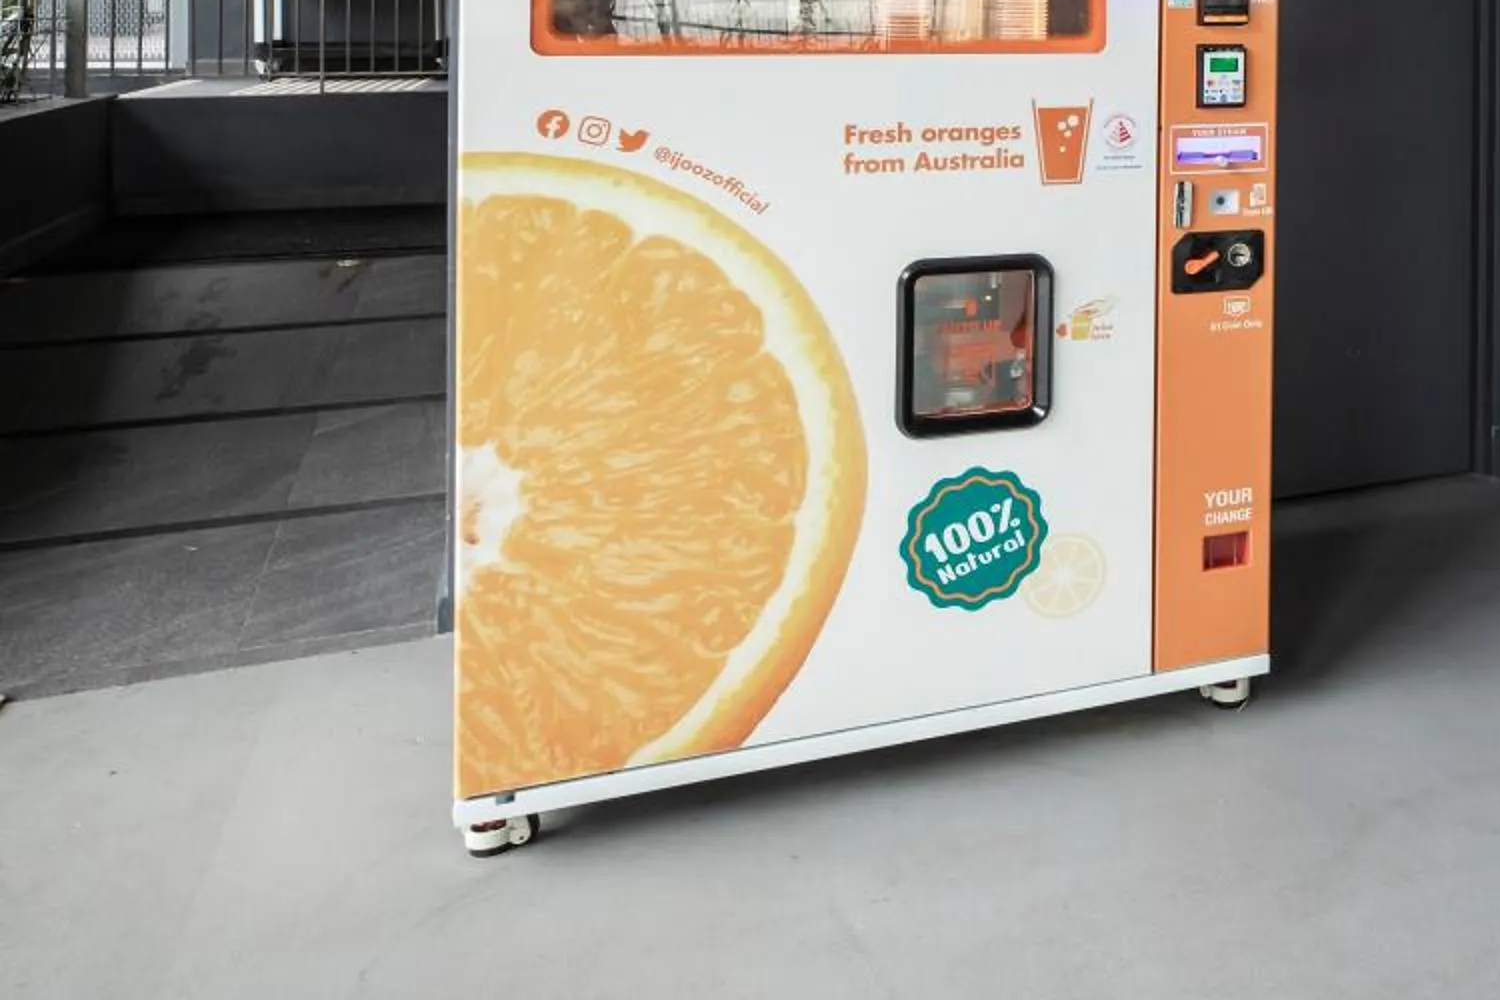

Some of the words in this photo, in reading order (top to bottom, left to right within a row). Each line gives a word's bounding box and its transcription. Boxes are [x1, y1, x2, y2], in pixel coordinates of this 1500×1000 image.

[844, 122, 913, 144] Fresh
[921, 124, 1022, 145] oranges
[844, 152, 905, 174] from
[914, 148, 1025, 172] Australia
[654, 146, 771, 215] @ijoozofficial
[1203, 487, 1253, 509] YOUR
[1204, 507, 1253, 526] CHANGE
[925, 497, 1021, 563] 100%
[936, 529, 1025, 585] Natural
